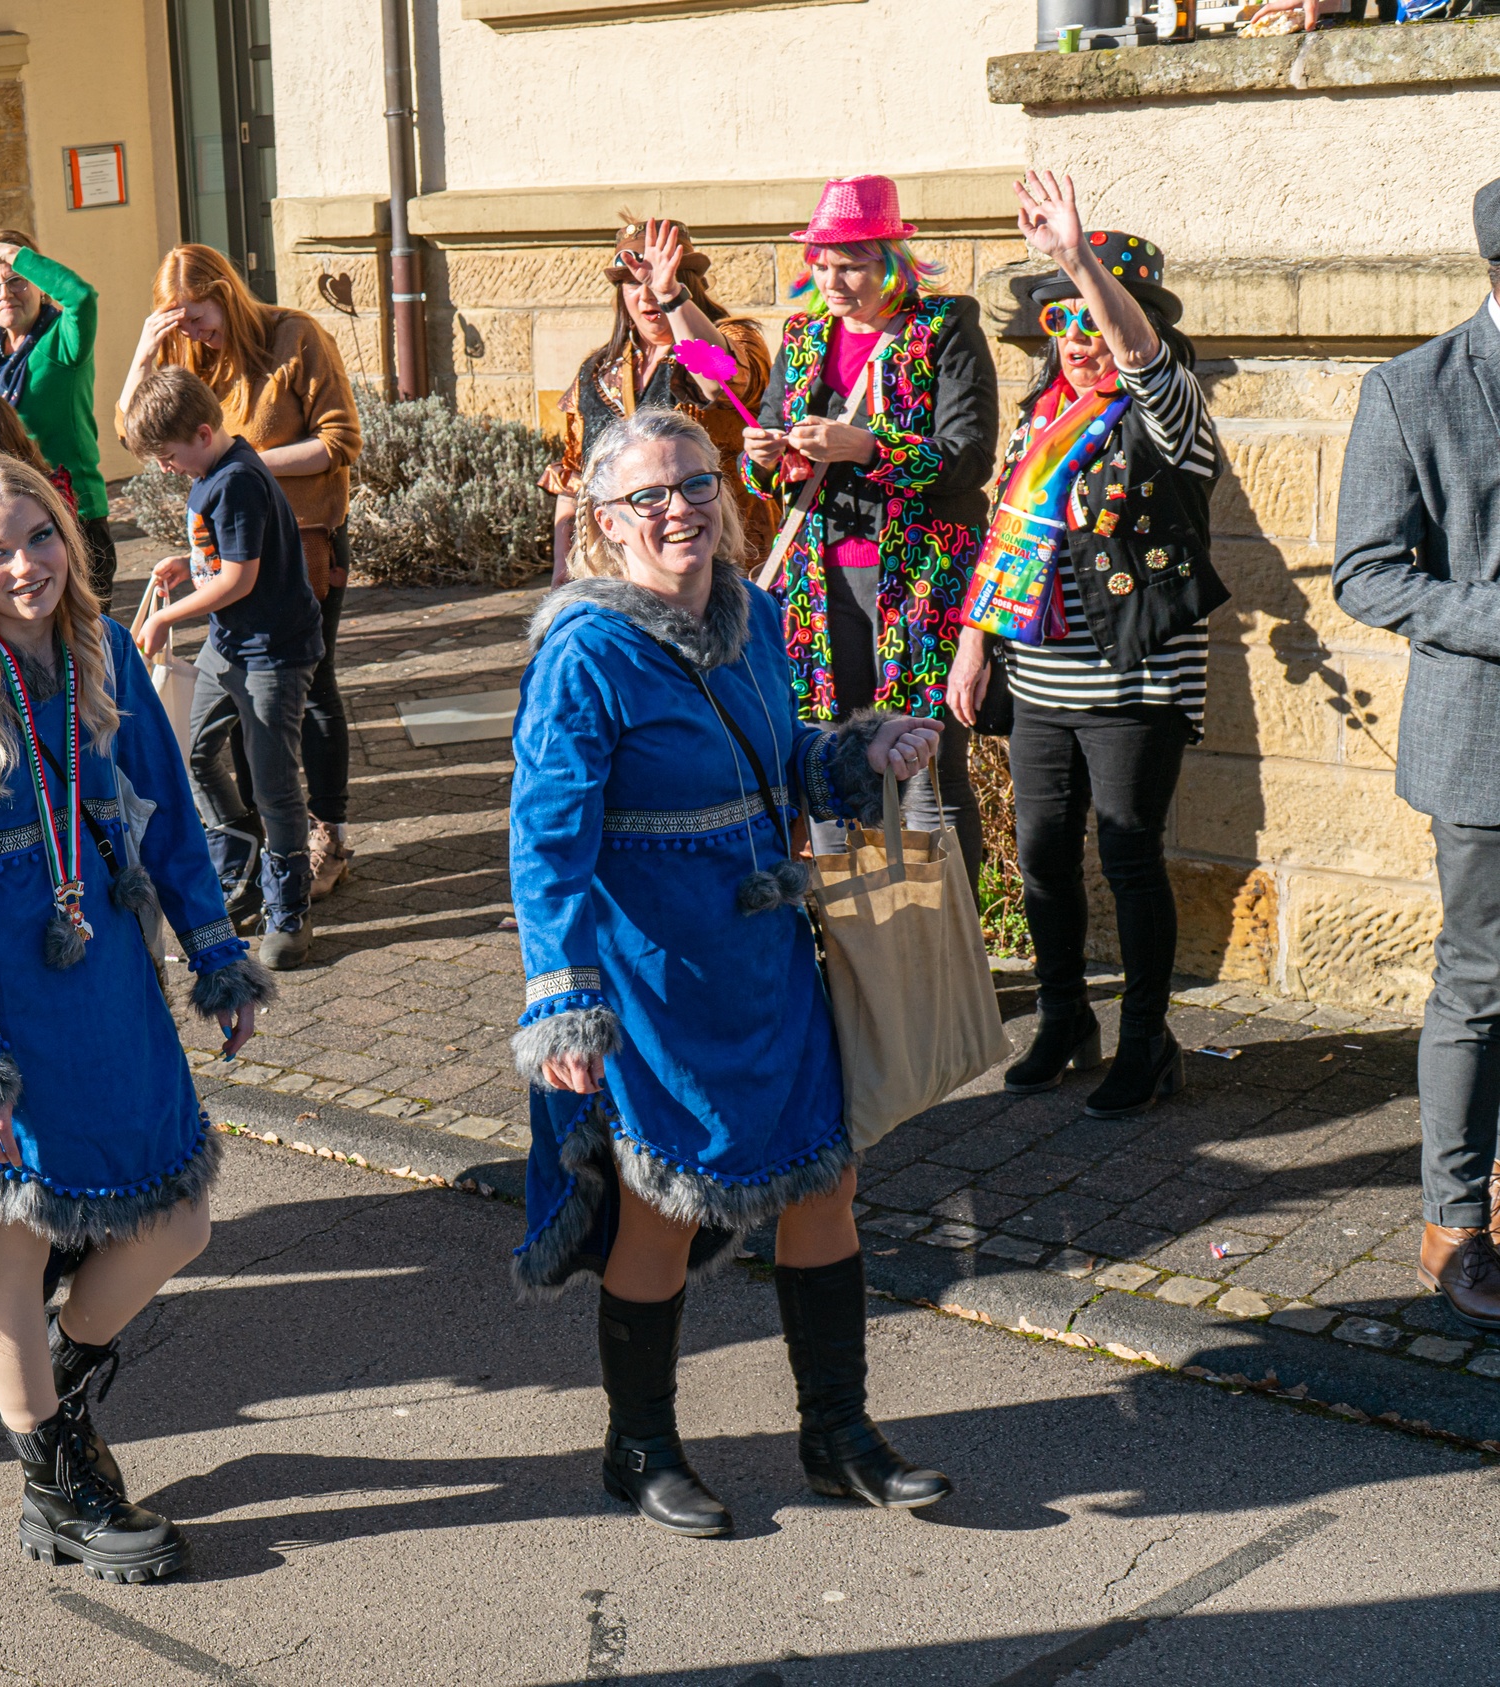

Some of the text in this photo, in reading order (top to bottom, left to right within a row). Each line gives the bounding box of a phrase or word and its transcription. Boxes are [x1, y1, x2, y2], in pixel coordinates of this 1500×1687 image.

[1001, 531, 1032, 551] KÖLNER
[992, 597, 1033, 617] ODER QUER
